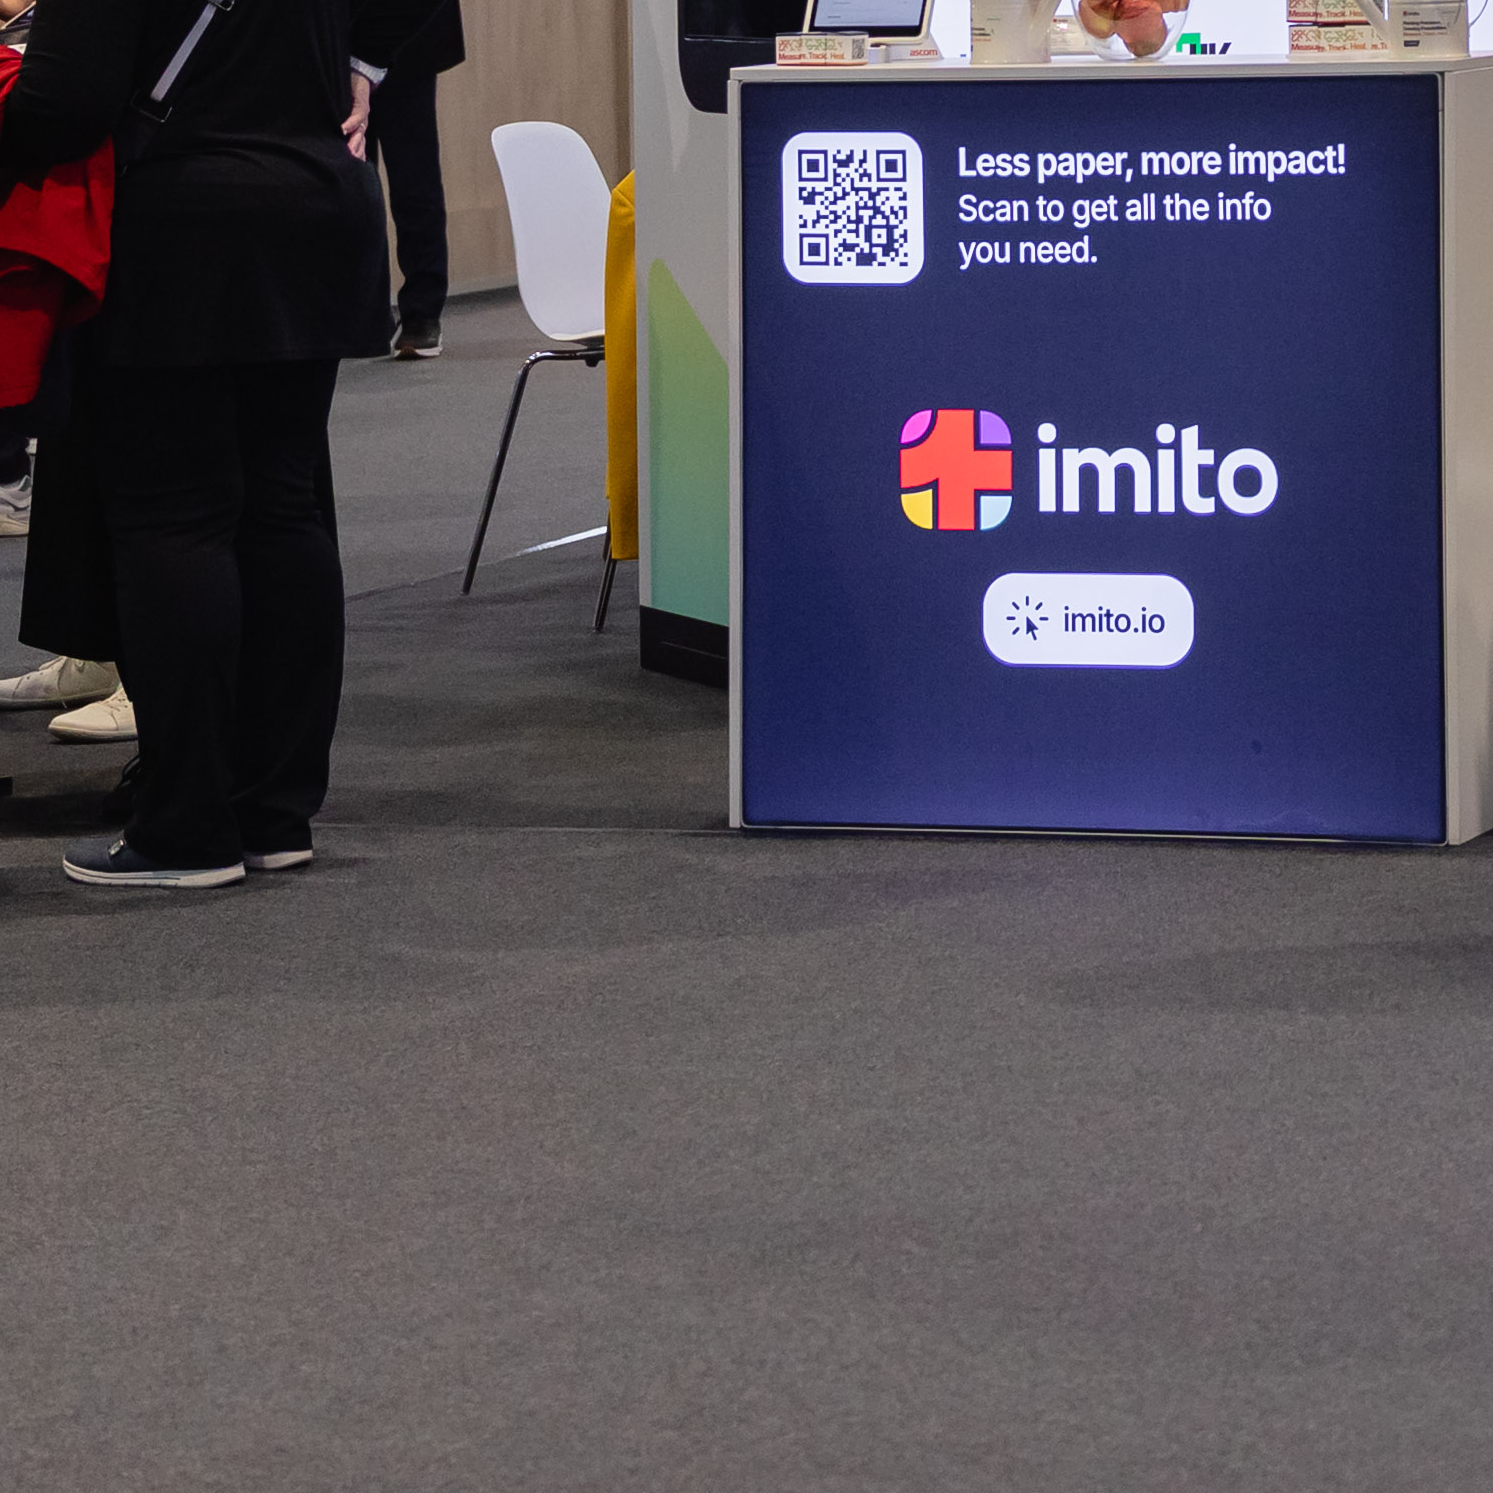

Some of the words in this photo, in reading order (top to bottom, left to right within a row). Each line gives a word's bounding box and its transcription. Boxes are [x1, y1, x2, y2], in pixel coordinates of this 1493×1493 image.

[958, 146, 1031, 178] Less
[1037, 150, 1134, 182] paper,
[1141, 148, 1222, 178] more
[1228, 143, 1346, 179] impact!
[958, 194, 1029, 223] Scan
[1036, 196, 1065, 223] to
[1072, 196, 1119, 227] get
[1125, 194, 1156, 222] all
[1163, 192, 1211, 222] the
[1217, 192, 1271, 221] info
[958, 240, 1011, 269] you
[1019, 235, 1098, 264] need.
[1037, 423, 1278, 515] imito
[1063, 606, 1165, 635] imito.io
